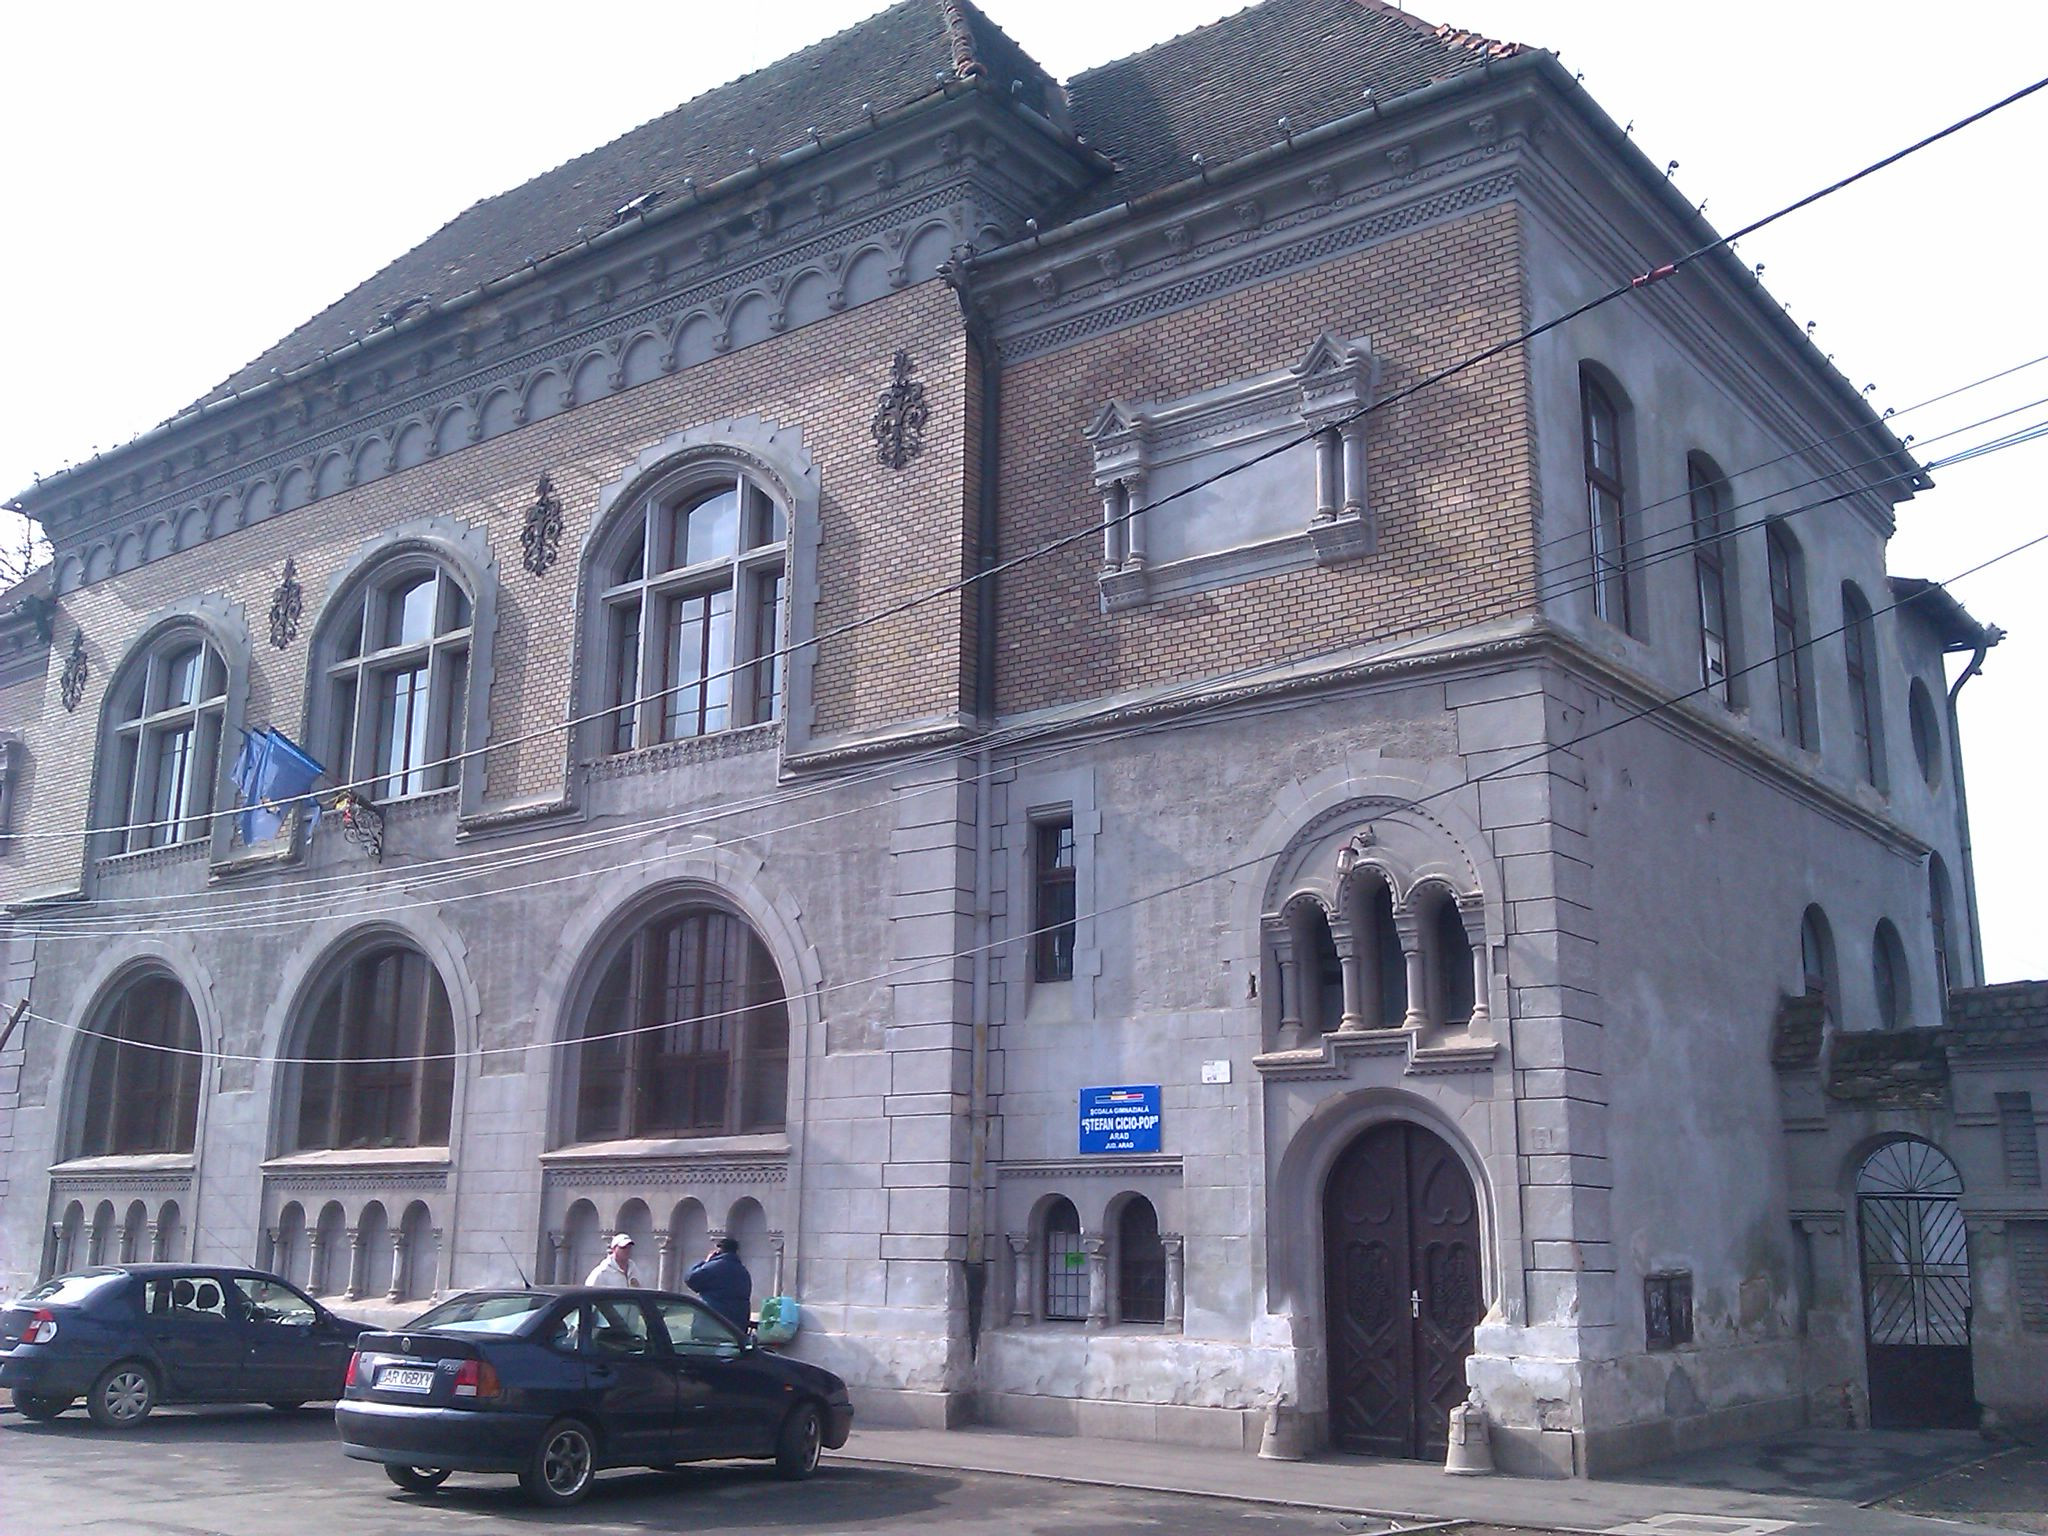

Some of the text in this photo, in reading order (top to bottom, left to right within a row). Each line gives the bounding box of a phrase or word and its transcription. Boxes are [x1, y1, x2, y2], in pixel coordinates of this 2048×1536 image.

[1109, 1132, 1130, 1140] ARAD
[1118, 1141, 1134, 1149] ARAD
[384, 1370, 399, 1383] AR
